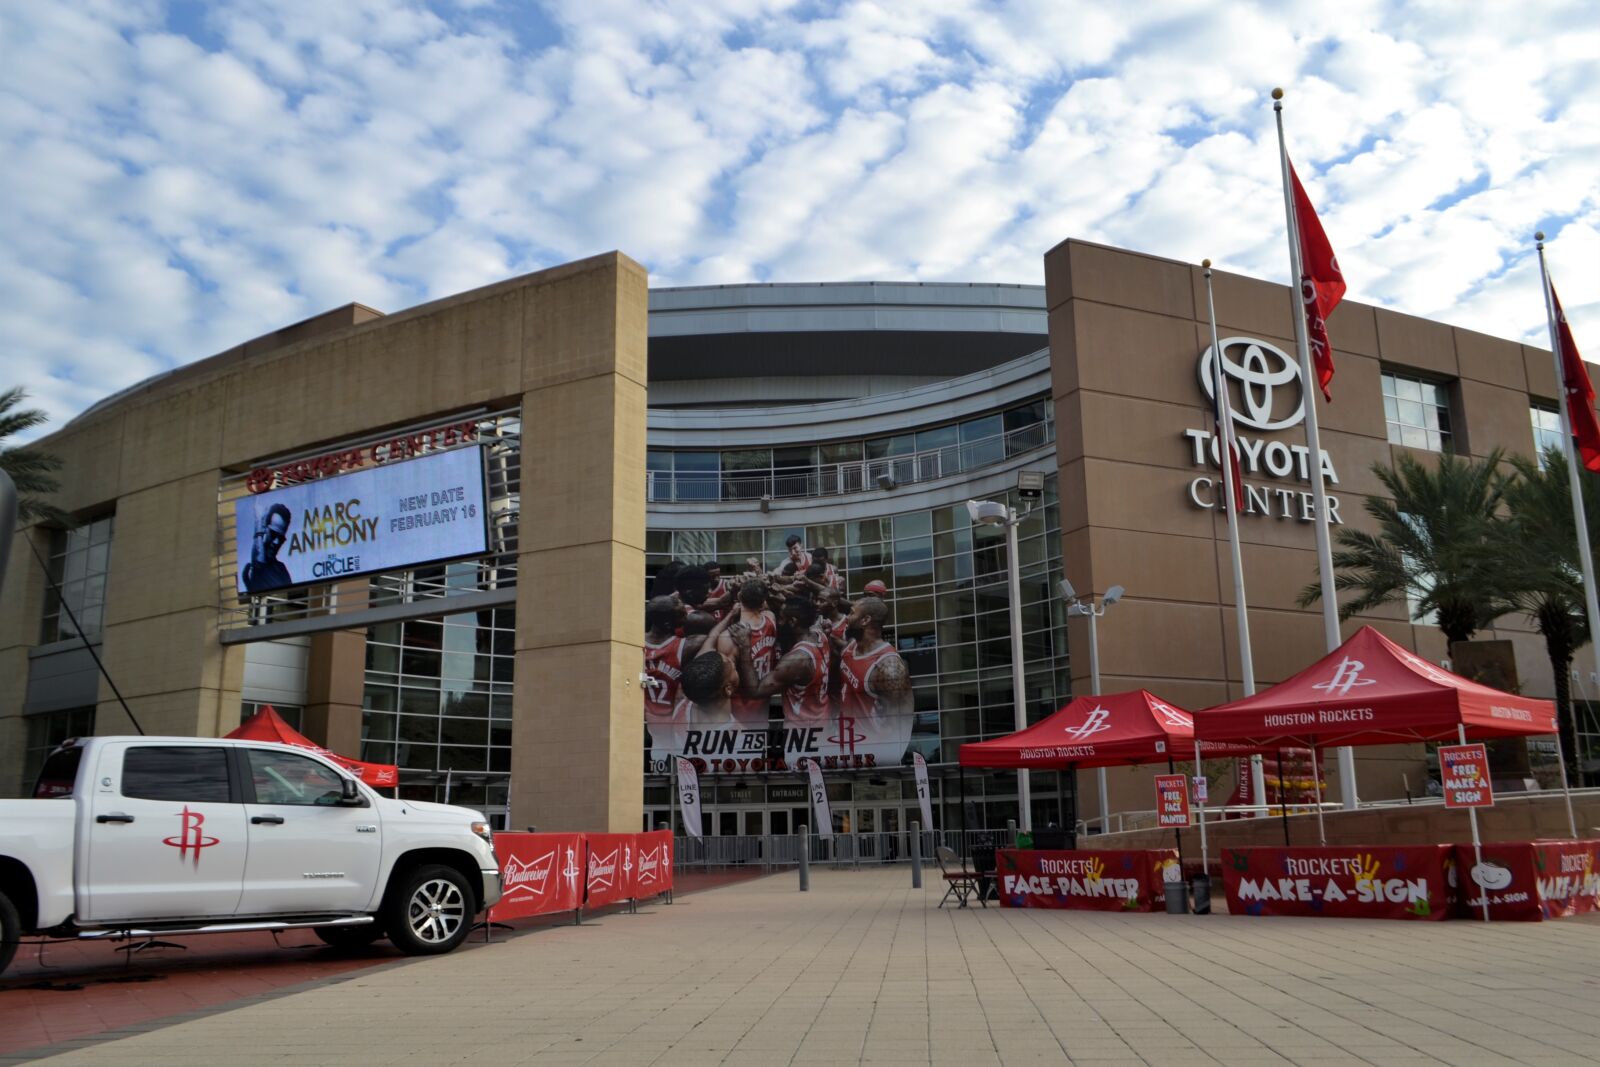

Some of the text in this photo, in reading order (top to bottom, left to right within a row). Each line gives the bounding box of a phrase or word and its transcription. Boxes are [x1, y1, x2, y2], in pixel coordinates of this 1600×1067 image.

[370, 420, 477, 463] CENTER
[399, 486, 465, 513] NEW DATE
[1190, 477, 1344, 525] CNTER
[303, 499, 361, 529] MARC
[390, 503, 476, 533] FEBRUARY 16
[288, 516, 379, 556] ANTHONY
[312, 556, 354, 578] CIRCLE
[1264, 708, 1374, 727] HOUSTON ROCKETS
[682, 730, 738, 755] RUN
[778, 727, 823, 753] NE
[1020, 745, 1095, 759] HOUSTON ROCKETS
[1444, 751, 1483, 761] ROCKETS
[711, 757, 789, 773] TOYOTA
[1453, 764, 1477, 776] FREE
[684, 793, 694, 805] 3
[772, 787, 804, 798] ENTRANCE
[815, 791, 824, 804] 2
[1164, 791, 1180, 801] FREE
[1455, 791, 1482, 803] SIGN
[1165, 803, 1181, 812] FACE
[1160, 814, 1187, 824] PAINTER
[589, 860, 615, 879] Budweiser
[1041, 858, 1093, 874] ROCKETS
[1286, 856, 1363, 876] ROCKETS
[1561, 853, 1590, 873] ROCKETS
[504, 862, 550, 886] Budweiser
[1003, 875, 1139, 899] FACE-PAINTER
[1238, 877, 1431, 903] MAKE-A-SIGN
[1466, 892, 1529, 907] AKE-A-SIGN
